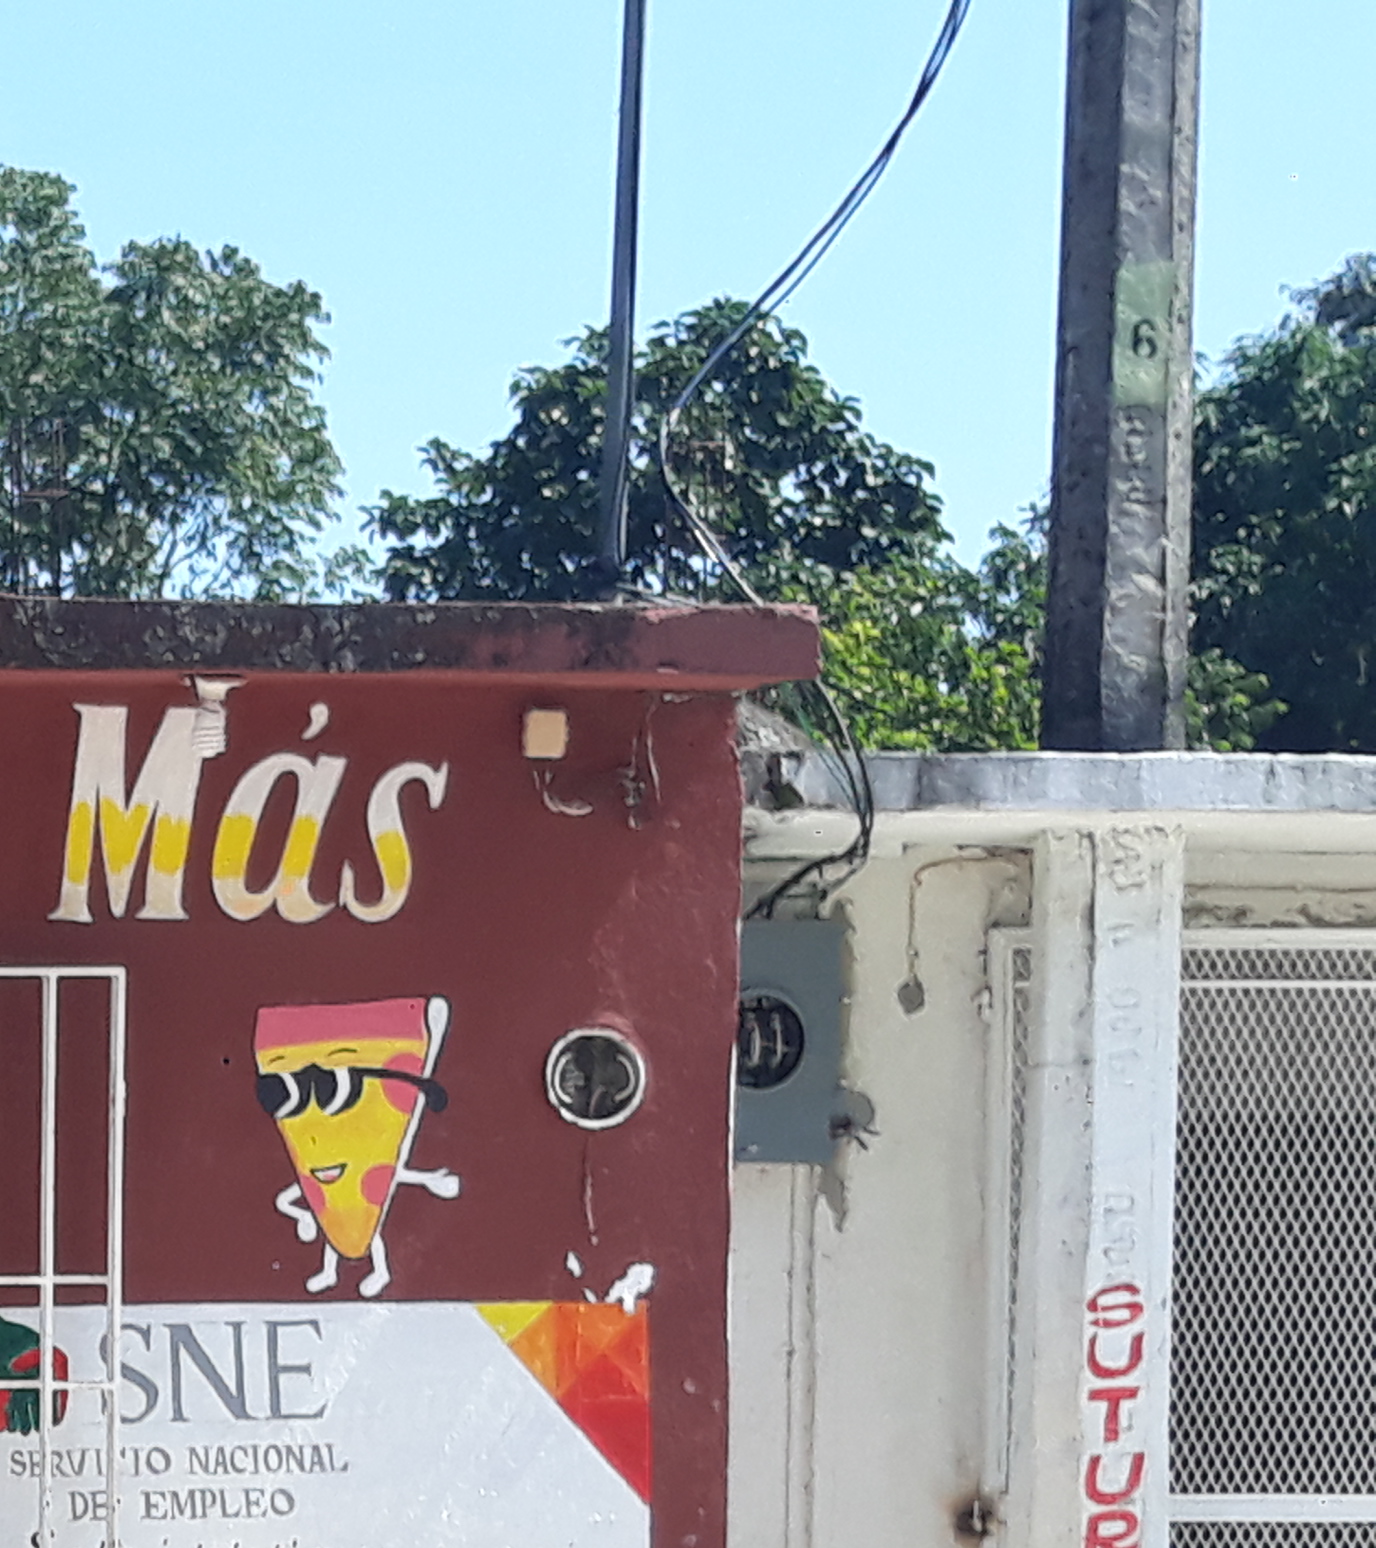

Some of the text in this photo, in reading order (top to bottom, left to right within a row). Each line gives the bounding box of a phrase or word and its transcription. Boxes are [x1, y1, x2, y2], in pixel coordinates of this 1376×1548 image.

[1130, 319, 1159, 361] 6
[47, 701, 449, 923] Más
[99, 1319, 331, 1425] SNE
[9, 1443, 350, 1478] SERVIIO NACIONAL
[68, 1487, 296, 1522] DE EMPLEO
